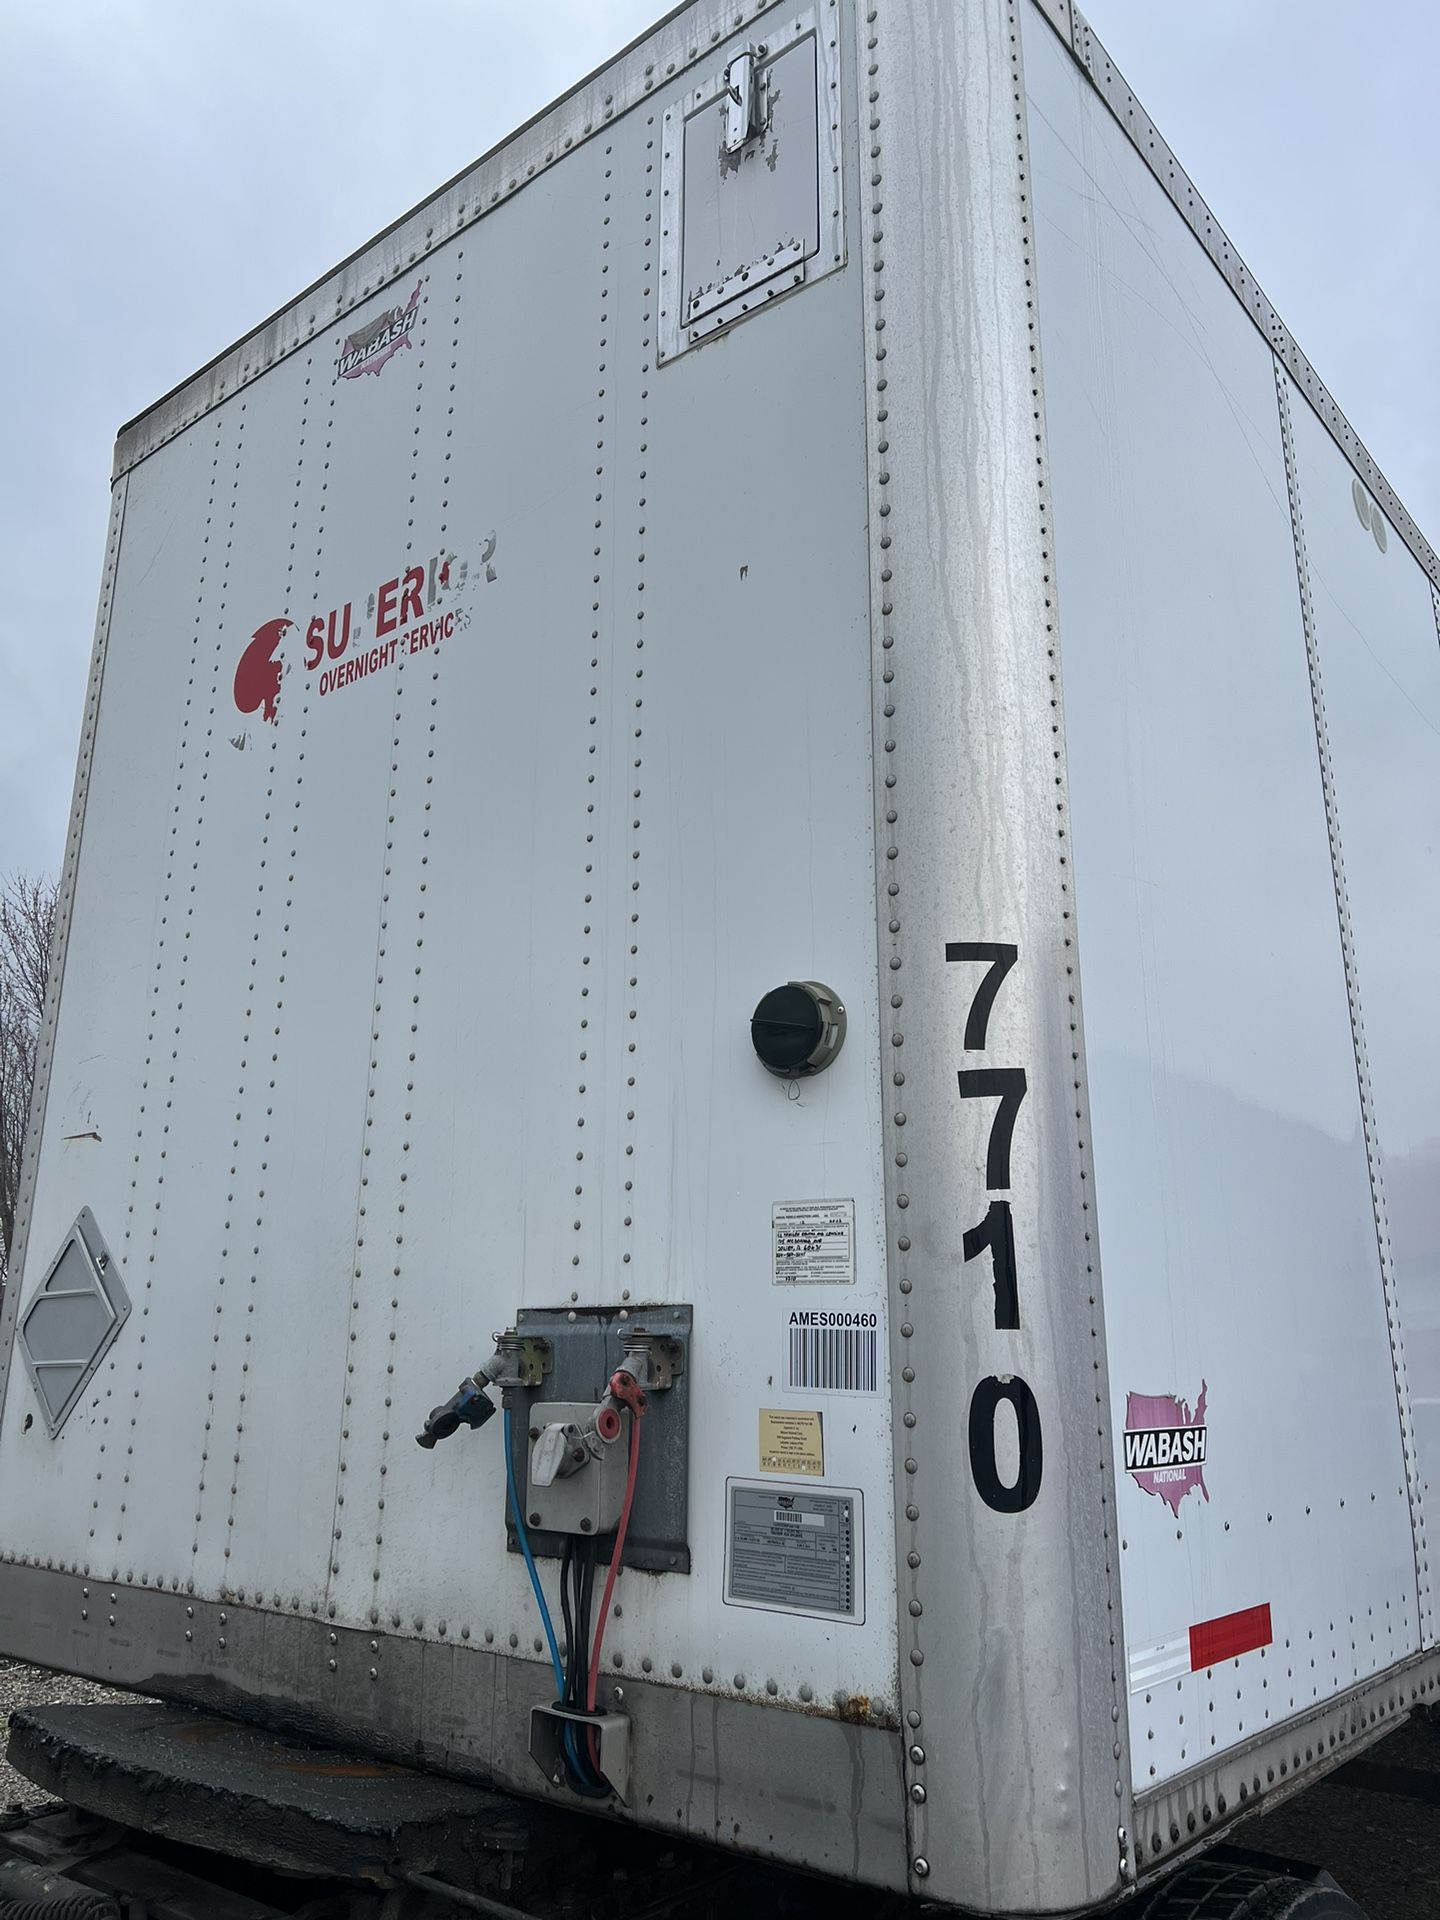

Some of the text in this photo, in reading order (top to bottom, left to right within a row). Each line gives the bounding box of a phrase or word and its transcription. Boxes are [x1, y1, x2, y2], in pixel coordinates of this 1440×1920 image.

[340, 308, 417, 376] WABASH
[319, 638, 398, 697] OVERNIGHT
[788, 1311, 877, 1327] AMES000460
[1125, 1429, 1206, 1468] WABASH
[1153, 1469, 1187, 1484] NATIONAL
